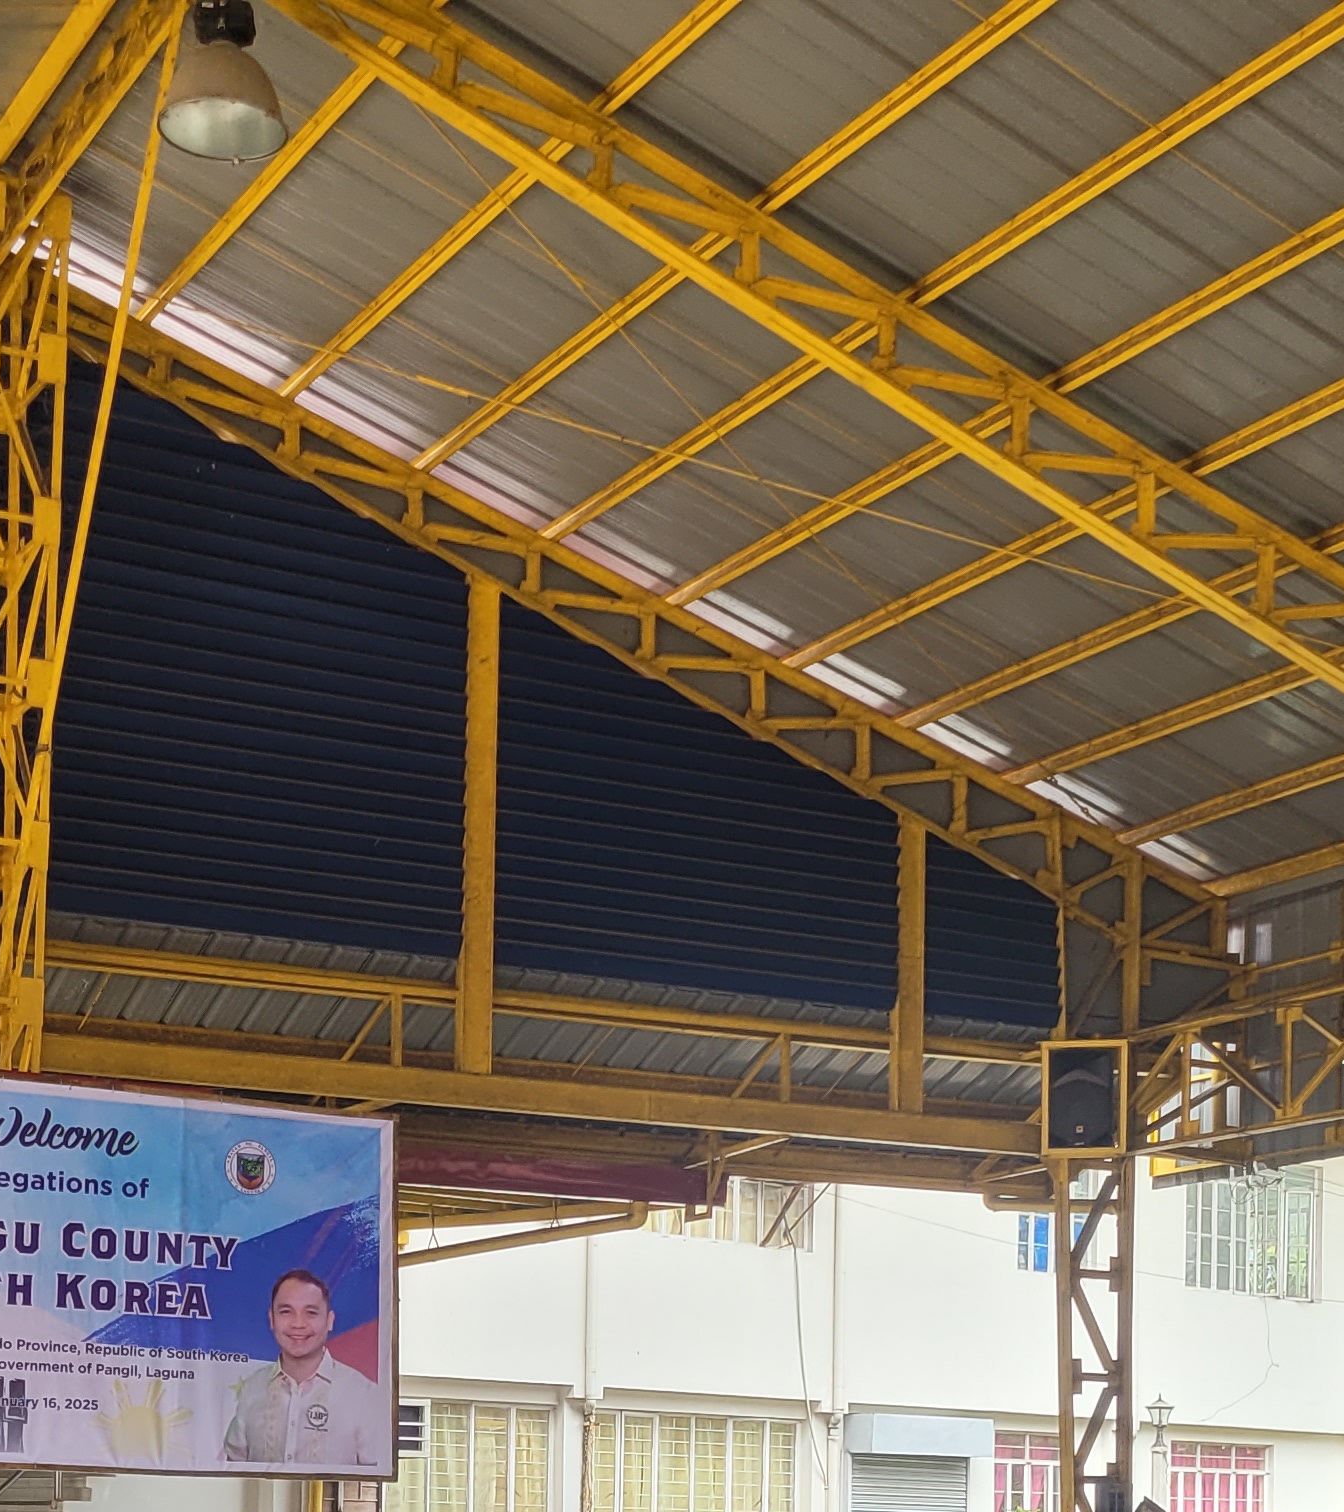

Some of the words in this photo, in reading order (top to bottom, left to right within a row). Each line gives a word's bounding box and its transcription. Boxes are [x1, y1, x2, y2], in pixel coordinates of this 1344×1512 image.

[121, 1177, 150, 1199] of
[61, 1220, 240, 1270] COUNTY
[55, 1272, 213, 1321] KOREA
[16, 1338, 82, 1356] Province,
[85, 1342, 146, 1359] Republic
[149, 1347, 164, 1359] of
[166, 1348, 206, 1361] South
[209, 1350, 250, 1363] Korea
[77, 1363, 92, 1375] of
[95, 1363, 143, 1379] Pangil,
[145, 1366, 195, 1381] Laguna
[42, 1397, 61, 1412] 16,
[64, 1398, 99, 1412] 2025
